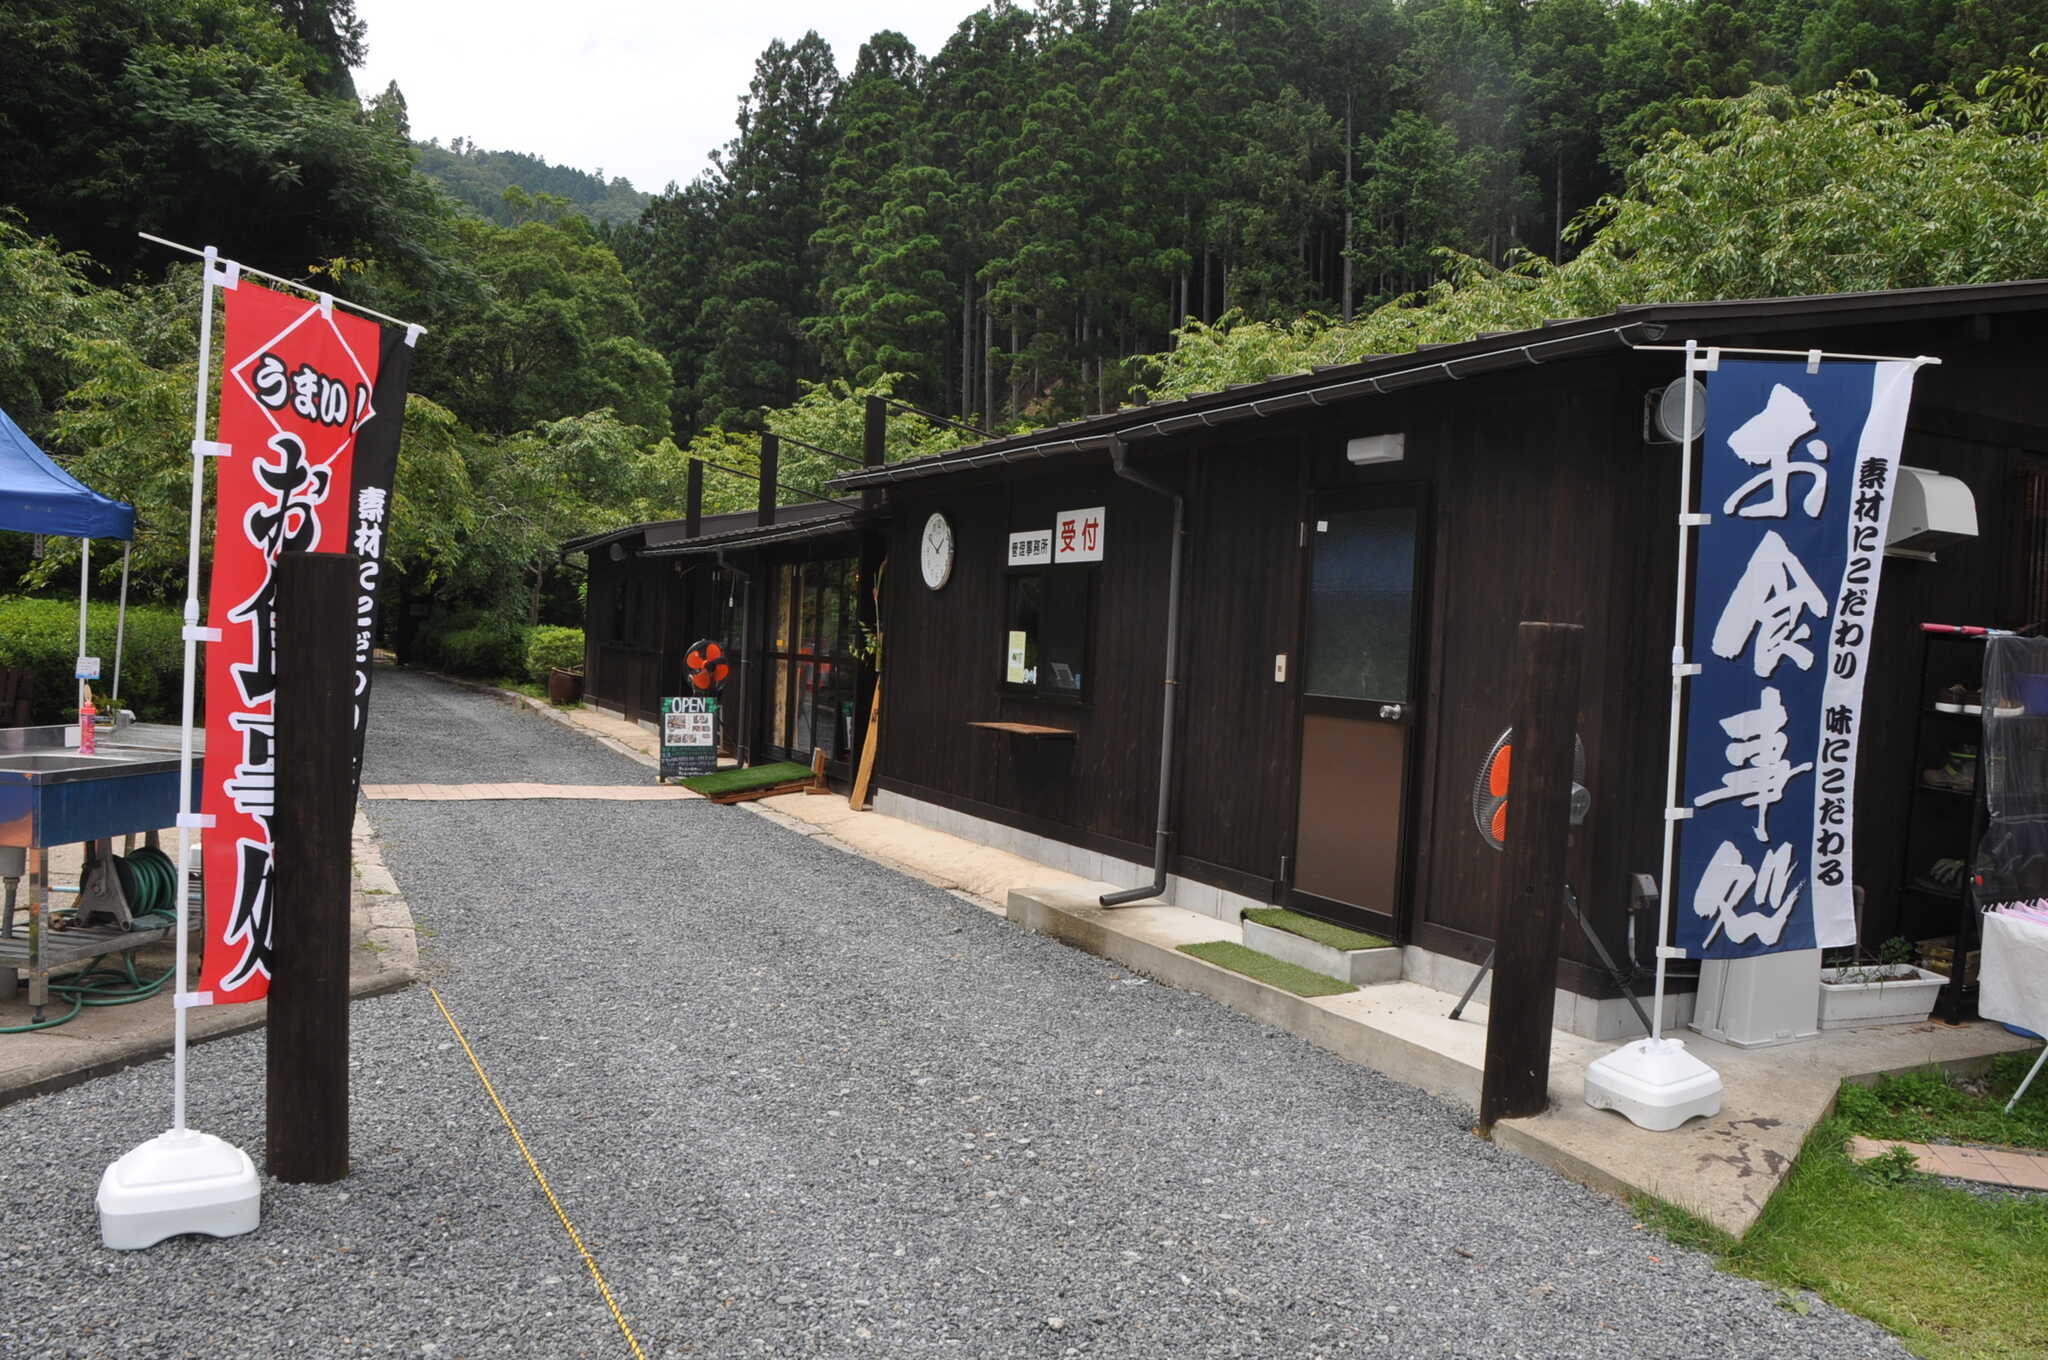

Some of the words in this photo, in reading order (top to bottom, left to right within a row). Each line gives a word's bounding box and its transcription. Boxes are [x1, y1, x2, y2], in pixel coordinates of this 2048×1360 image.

[254, 356, 367, 433] うまい!
[1060, 517, 1099, 553] 受付
[1834, 457, 1888, 679] 素材にこだわり
[671, 697, 706, 713] OPEN
[1694, 383, 1828, 950] お食事処
[1817, 705, 1853, 886] 味にこだわる
